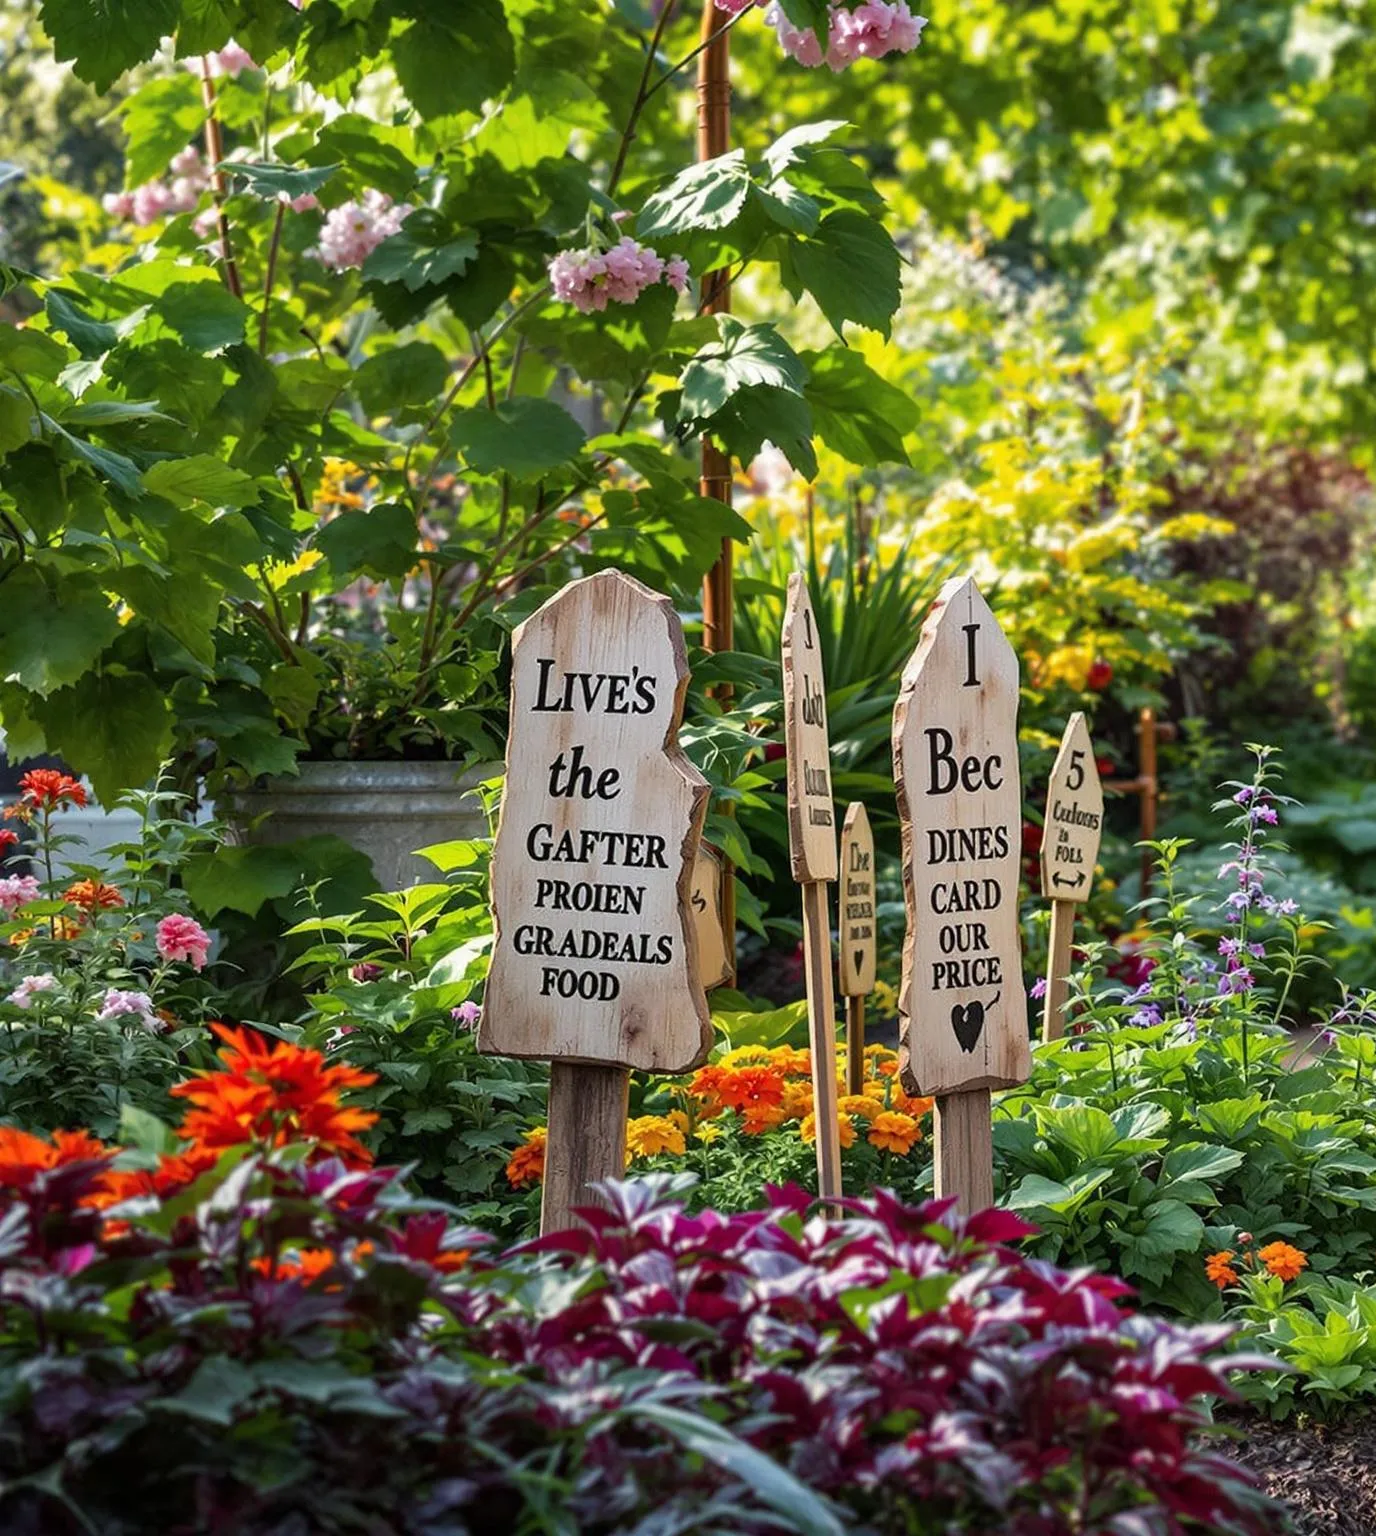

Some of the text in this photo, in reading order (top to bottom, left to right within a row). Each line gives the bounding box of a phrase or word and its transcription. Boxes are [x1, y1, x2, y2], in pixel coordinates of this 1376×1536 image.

[549, 745, 621, 800] the
[924, 728, 1004, 795] Bec
[1065, 750, 1085, 790] 5
[527, 823, 669, 868] GAFTER
[927, 826, 1009, 864] DINES
[534, 878, 647, 915] PROIEN
[931, 879, 1001, 914] CARD
[513, 925, 673, 965] GRADEALS
[939, 923, 989, 954] OUR
[540, 967, 620, 1001] FOOD
[932, 957, 1003, 990] PRICE
